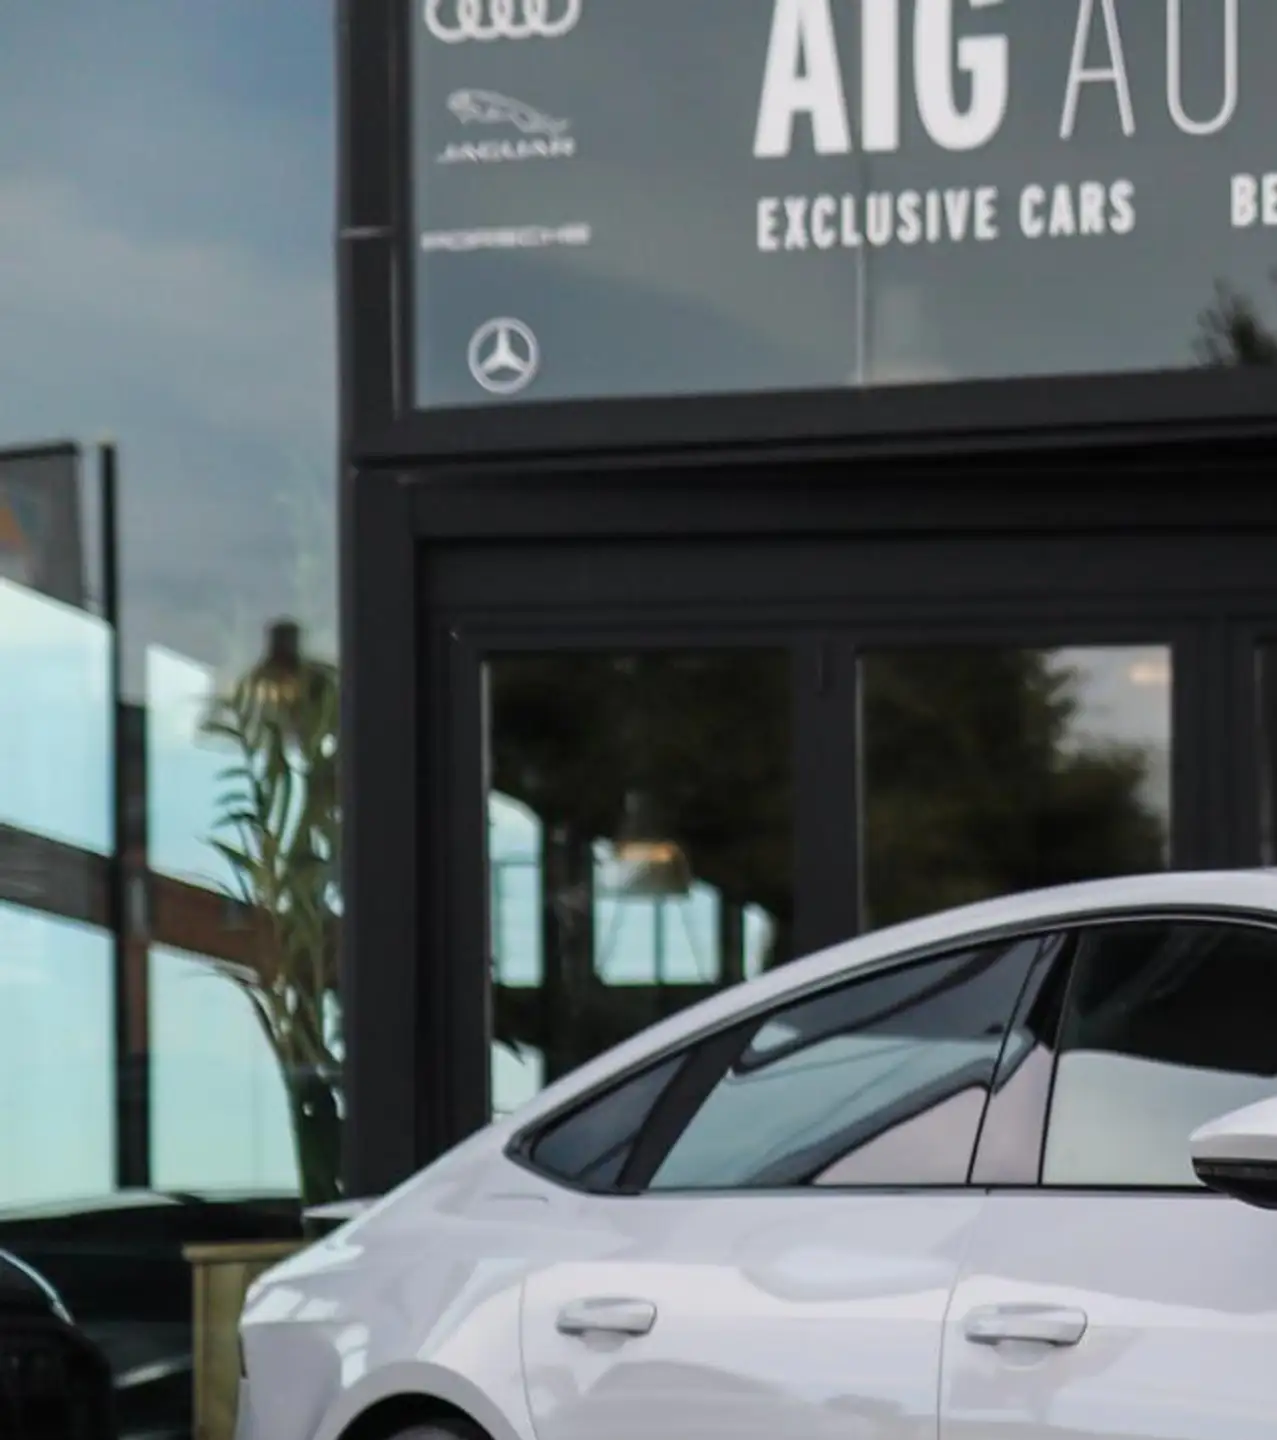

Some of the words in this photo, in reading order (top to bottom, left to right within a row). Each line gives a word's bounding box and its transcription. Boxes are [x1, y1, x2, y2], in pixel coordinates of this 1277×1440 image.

[753, 0, 1009, 157] AIG
[436, 137, 577, 165] JAGUAR
[756, 186, 999, 252] EXCLUSIVE
[1018, 179, 1137, 240] CARS
